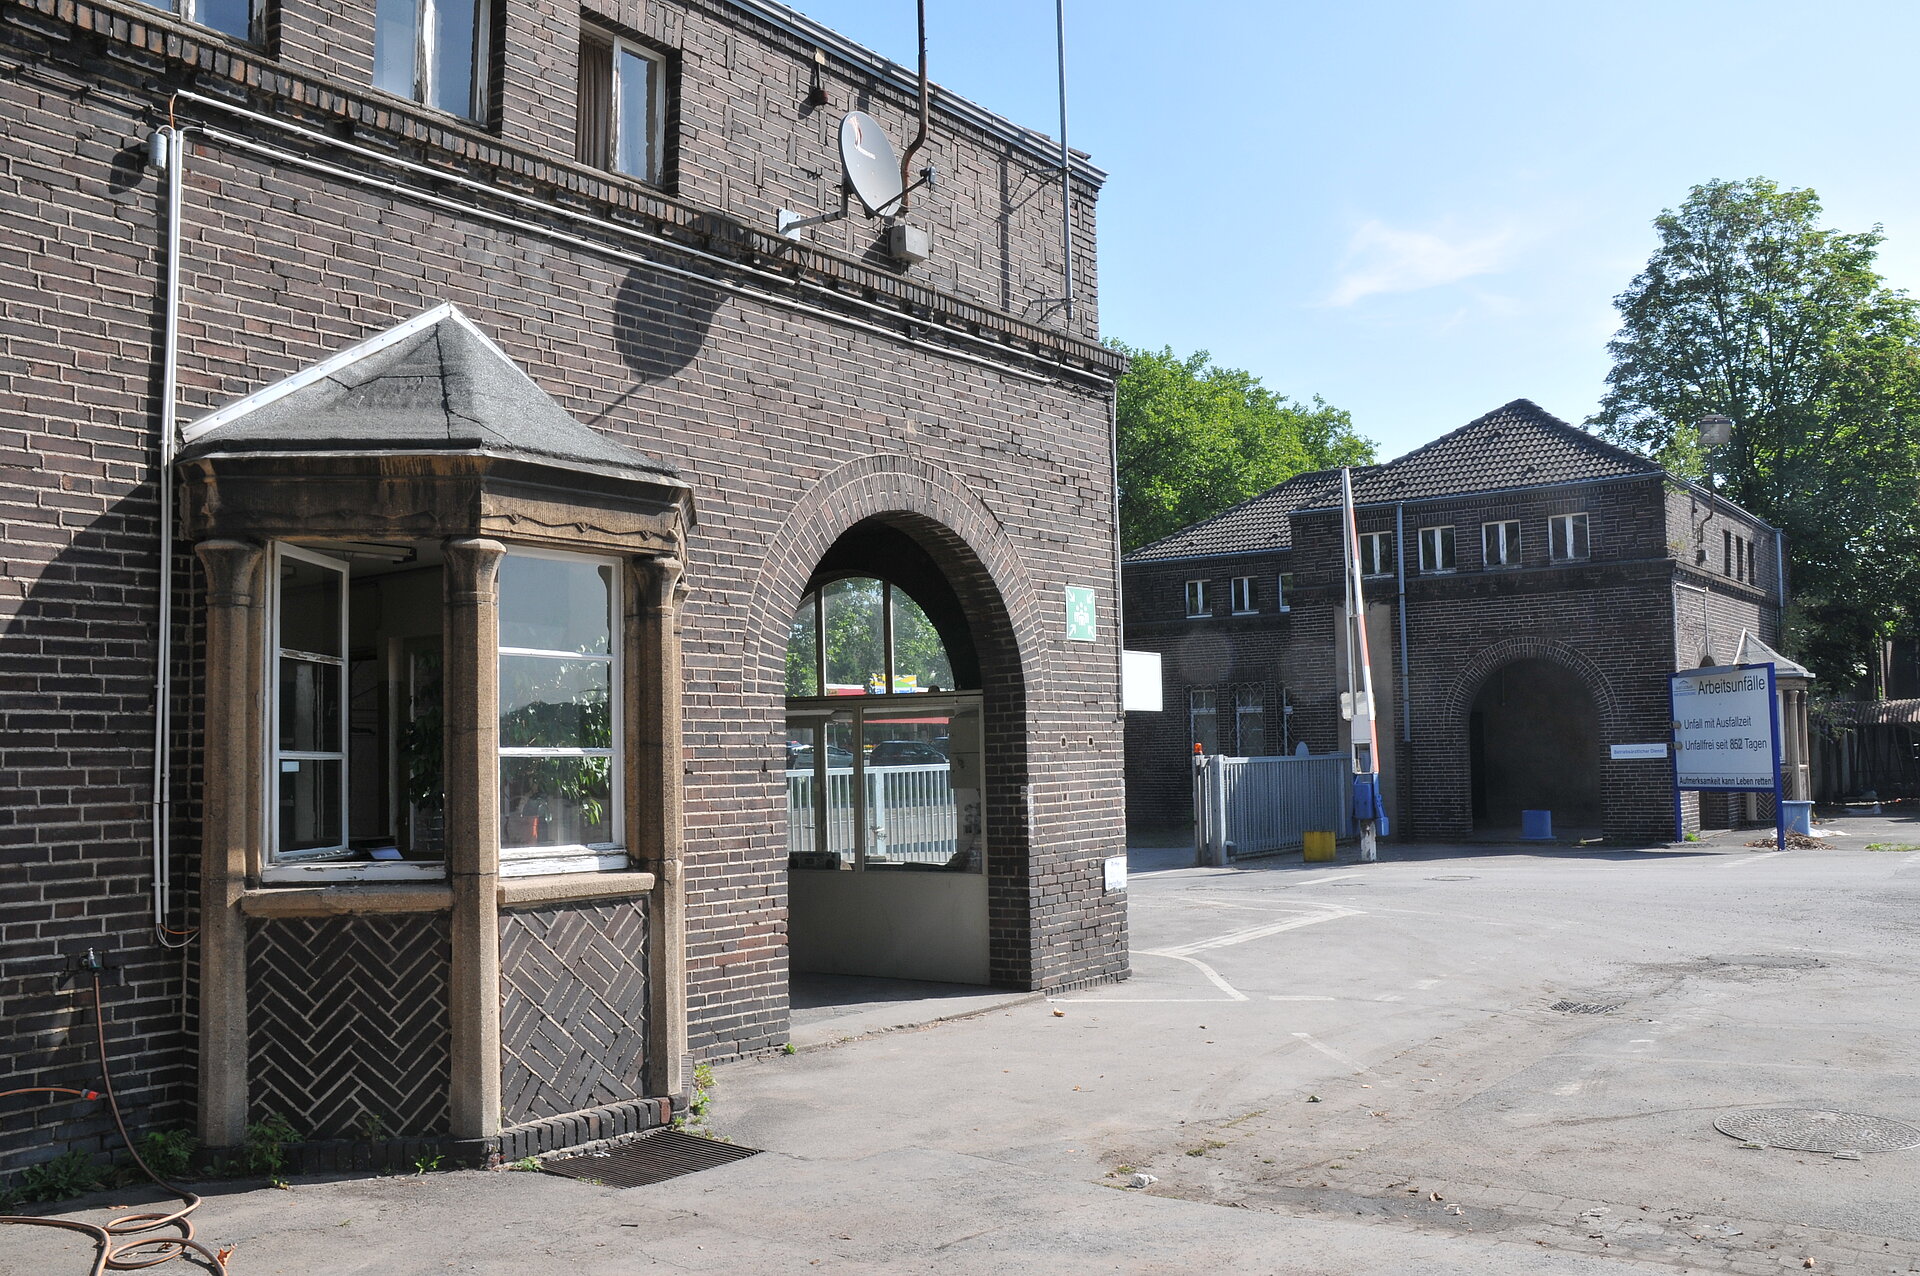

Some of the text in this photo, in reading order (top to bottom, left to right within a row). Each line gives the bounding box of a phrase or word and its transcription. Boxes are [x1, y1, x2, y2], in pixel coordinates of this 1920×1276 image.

[1698, 675, 1766, 695] Arbeitsunfälle
[1684, 715, 1752, 730] Unfall mit Ausfallzeit
[1685, 739, 1714, 751] Unfallfrei
[1715, 739, 1729, 750] seit
[1744, 737, 1768, 752] Tagen
[1679, 776, 1721, 786] Aufmerksamkeit
[1722, 776, 1735, 785] kann
[1736, 776, 1754, 786] Leben
